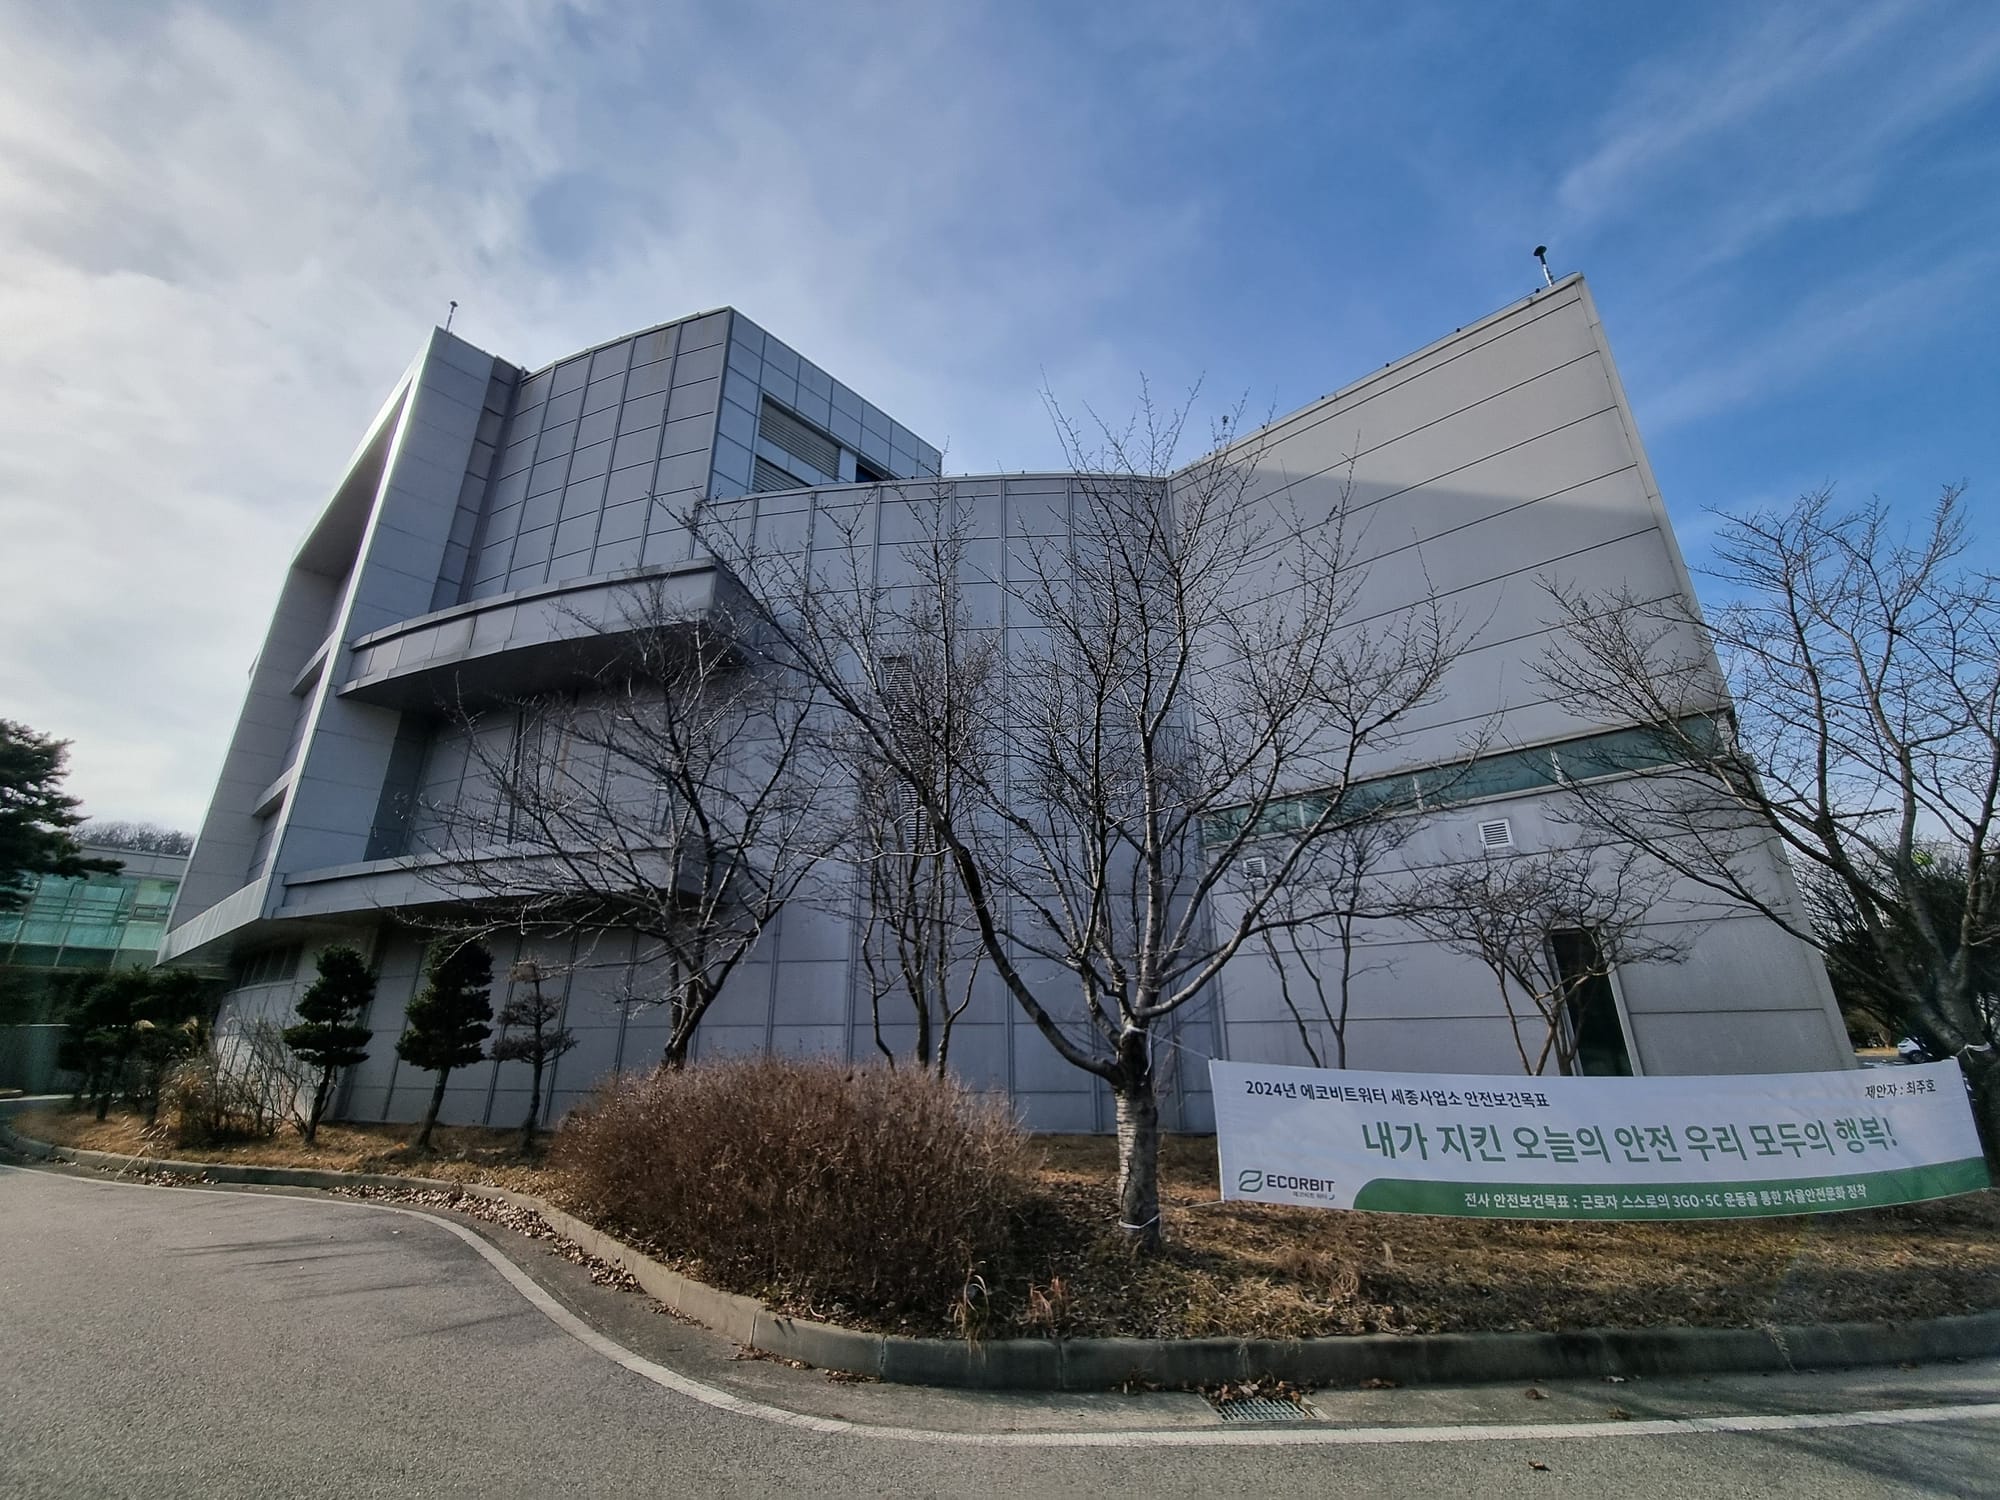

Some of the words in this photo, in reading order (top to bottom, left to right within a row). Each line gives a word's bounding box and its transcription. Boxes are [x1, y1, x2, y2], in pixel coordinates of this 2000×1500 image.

[1245, 1081, 1297, 1099] 2024년
[1300, 1084, 1387, 1104] 에코비트워터
[1391, 1088, 1463, 1107] 세종사업소
[1464, 1091, 1550, 1108] 안전보건목표
[1906, 1079, 1936, 1095] 최주호
[1362, 1121, 1428, 1160] 내가
[1437, 1123, 1506, 1162] 지킨
[1513, 1125, 1611, 1164] 오늘의
[1615, 1124, 1682, 1163] 안전
[1685, 1124, 1748, 1162] 우리
[1749, 1119, 1836, 1158] 모두의
[1833, 1117, 1898, 1155] 행복!
[1267, 1174, 1335, 1192] ECORBIT
[1464, 1193, 1490, 1208] 전사
[1493, 1193, 1570, 1210] 안전보건목표
[1581, 1194, 1618, 1210] 근로자
[1622, 1193, 1670, 1209] 스스로의
[1724, 1192, 1759, 1208] 운동을
[1760, 1190, 1782, 1206] 통한
[1847, 1184, 1866, 1198] 정착
